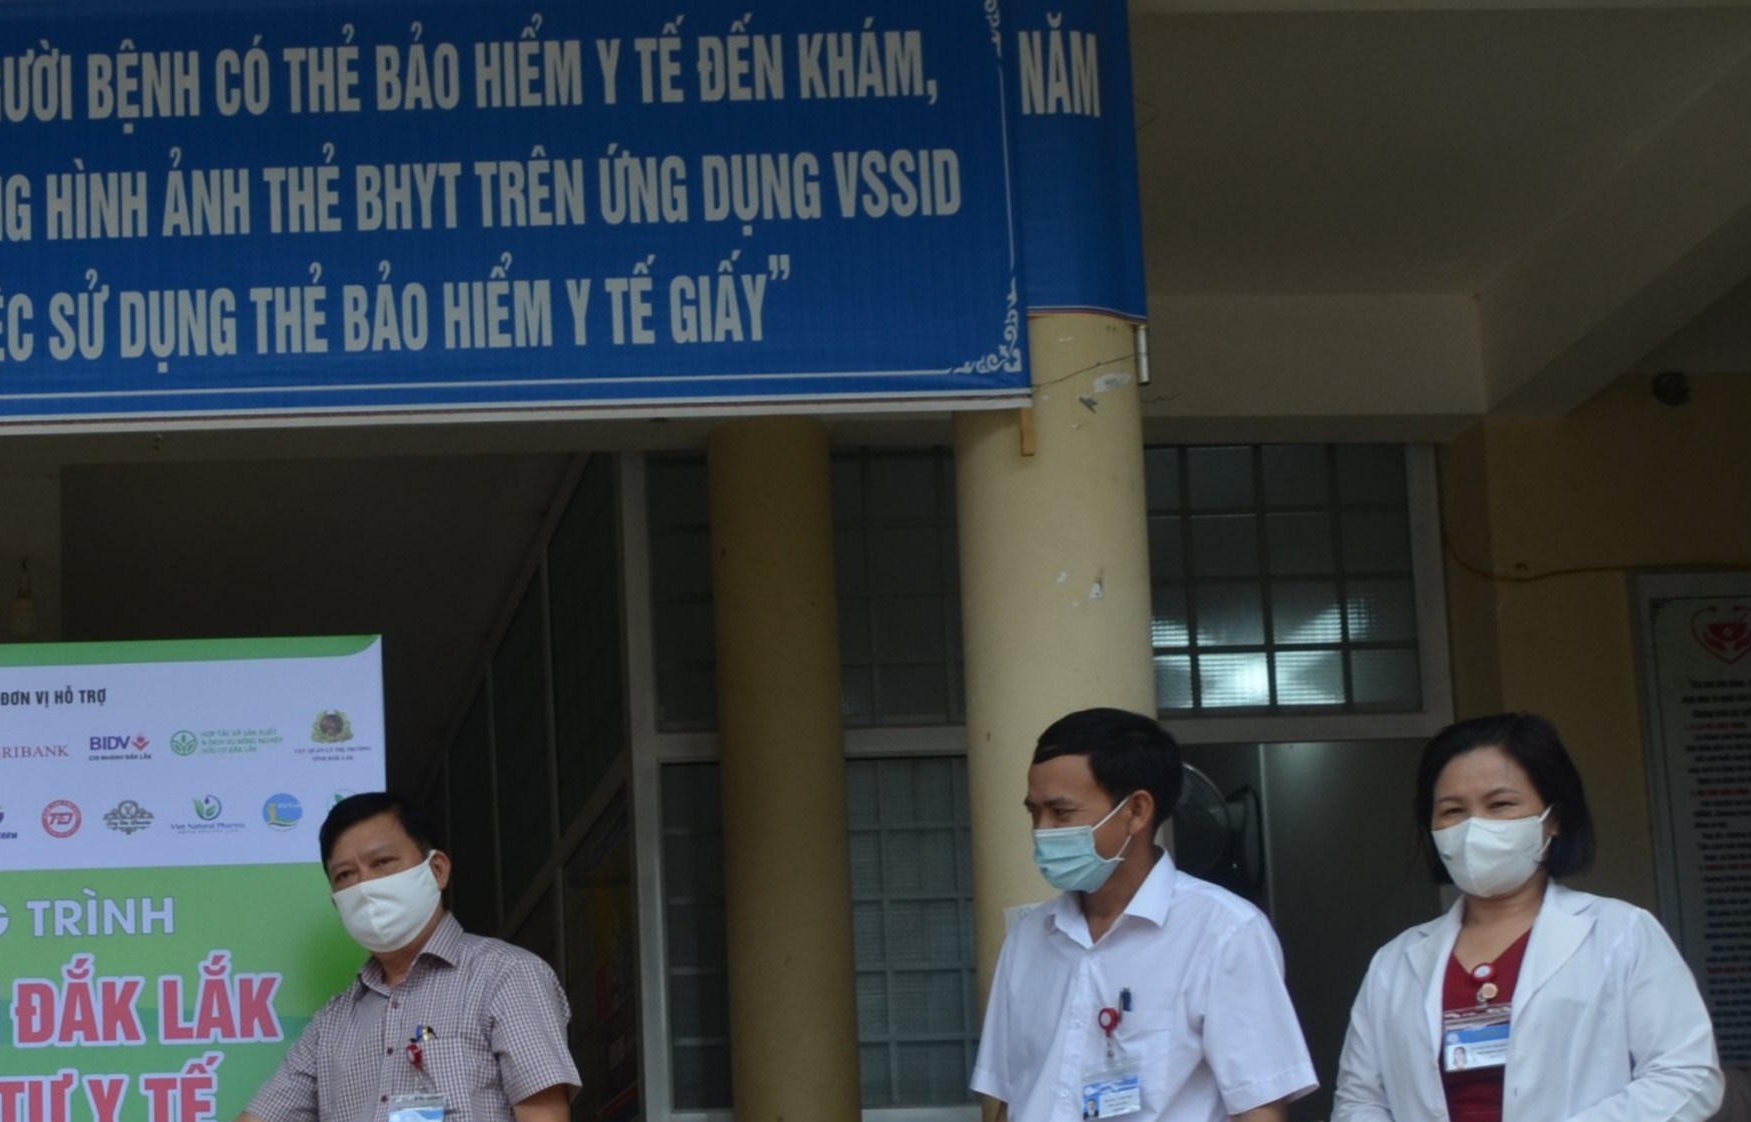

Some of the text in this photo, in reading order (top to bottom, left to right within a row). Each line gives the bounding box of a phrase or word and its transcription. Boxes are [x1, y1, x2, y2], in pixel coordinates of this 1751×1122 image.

[88, 39, 199, 134] BỆNH
[215, 34, 271, 116] CÓ
[285, 23, 360, 114] THẺ
[376, 21, 456, 111] BẢO
[475, 13, 583, 109] HIỂM
[596, 38, 620, 104] Y
[635, 11, 684, 103] TẾ
[697, 10, 788, 102] ĐẾN
[799, 17, 939, 106] KHÁM,
[1019, 10, 1101, 118] NĂM
[47, 159, 148, 241] HÌNH
[162, 146, 250, 237] ẢNH
[263, 142, 341, 233] THẺ
[356, 159, 462, 231] BHYT
[475, 146, 585, 228] TRÊN
[598, 142, 688, 224] ỨNG
[703, 151, 820, 237] DỤNG
[833, 147, 961, 219] VSSID
[49, 268, 109, 362] SỬ
[120, 286, 237, 374] DỤNG
[252, 261, 328, 355] THẺ
[342, 259, 428, 352] BẢO
[444, 251, 554, 350] HIỂM
[566, 277, 591, 346] Y
[605, 253, 656, 345] TẾ
[0, 684, 107, 709] ĐƠN VỊ HỖ TRỢ
[89, 735, 130, 751] BIDV
[27, 886, 177, 938] TRÌNH
[13, 955, 143, 1046] ĐẮK
[161, 953, 280, 1042] LẮK
